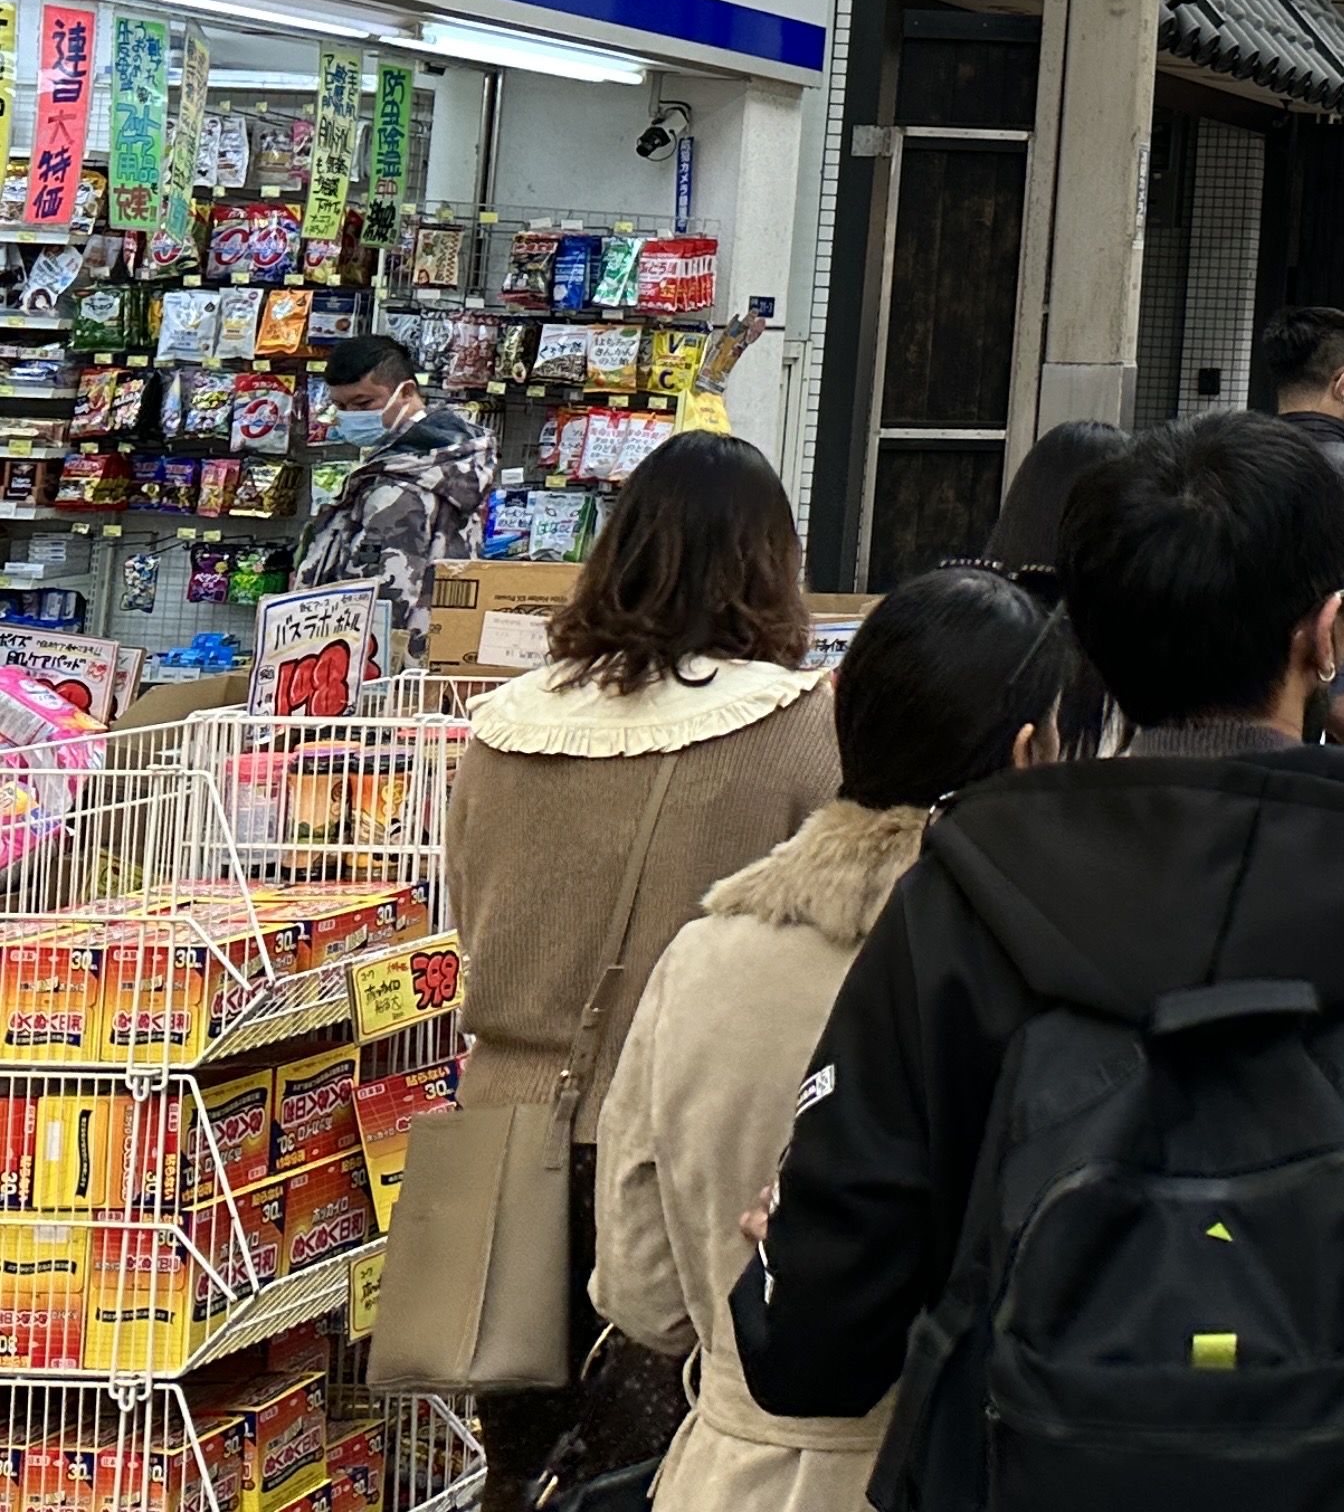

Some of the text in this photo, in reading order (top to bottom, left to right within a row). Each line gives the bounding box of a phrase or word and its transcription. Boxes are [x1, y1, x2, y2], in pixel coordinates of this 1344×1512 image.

[33, 19, 87, 219] 連日大特価
[6, 650, 87, 671] 肌ケアパッド
[376, 905, 394, 926] 30
[275, 931, 295, 953] 30
[72, 951, 94, 970] 30
[175, 950, 197, 969] 30
[405, 1067, 451, 1087] 貼らない
[425, 1080, 446, 1101] 30
[312, 1196, 348, 1224] ホッカイロ
[290, 1208, 366, 1263] ぬくぬく日和
